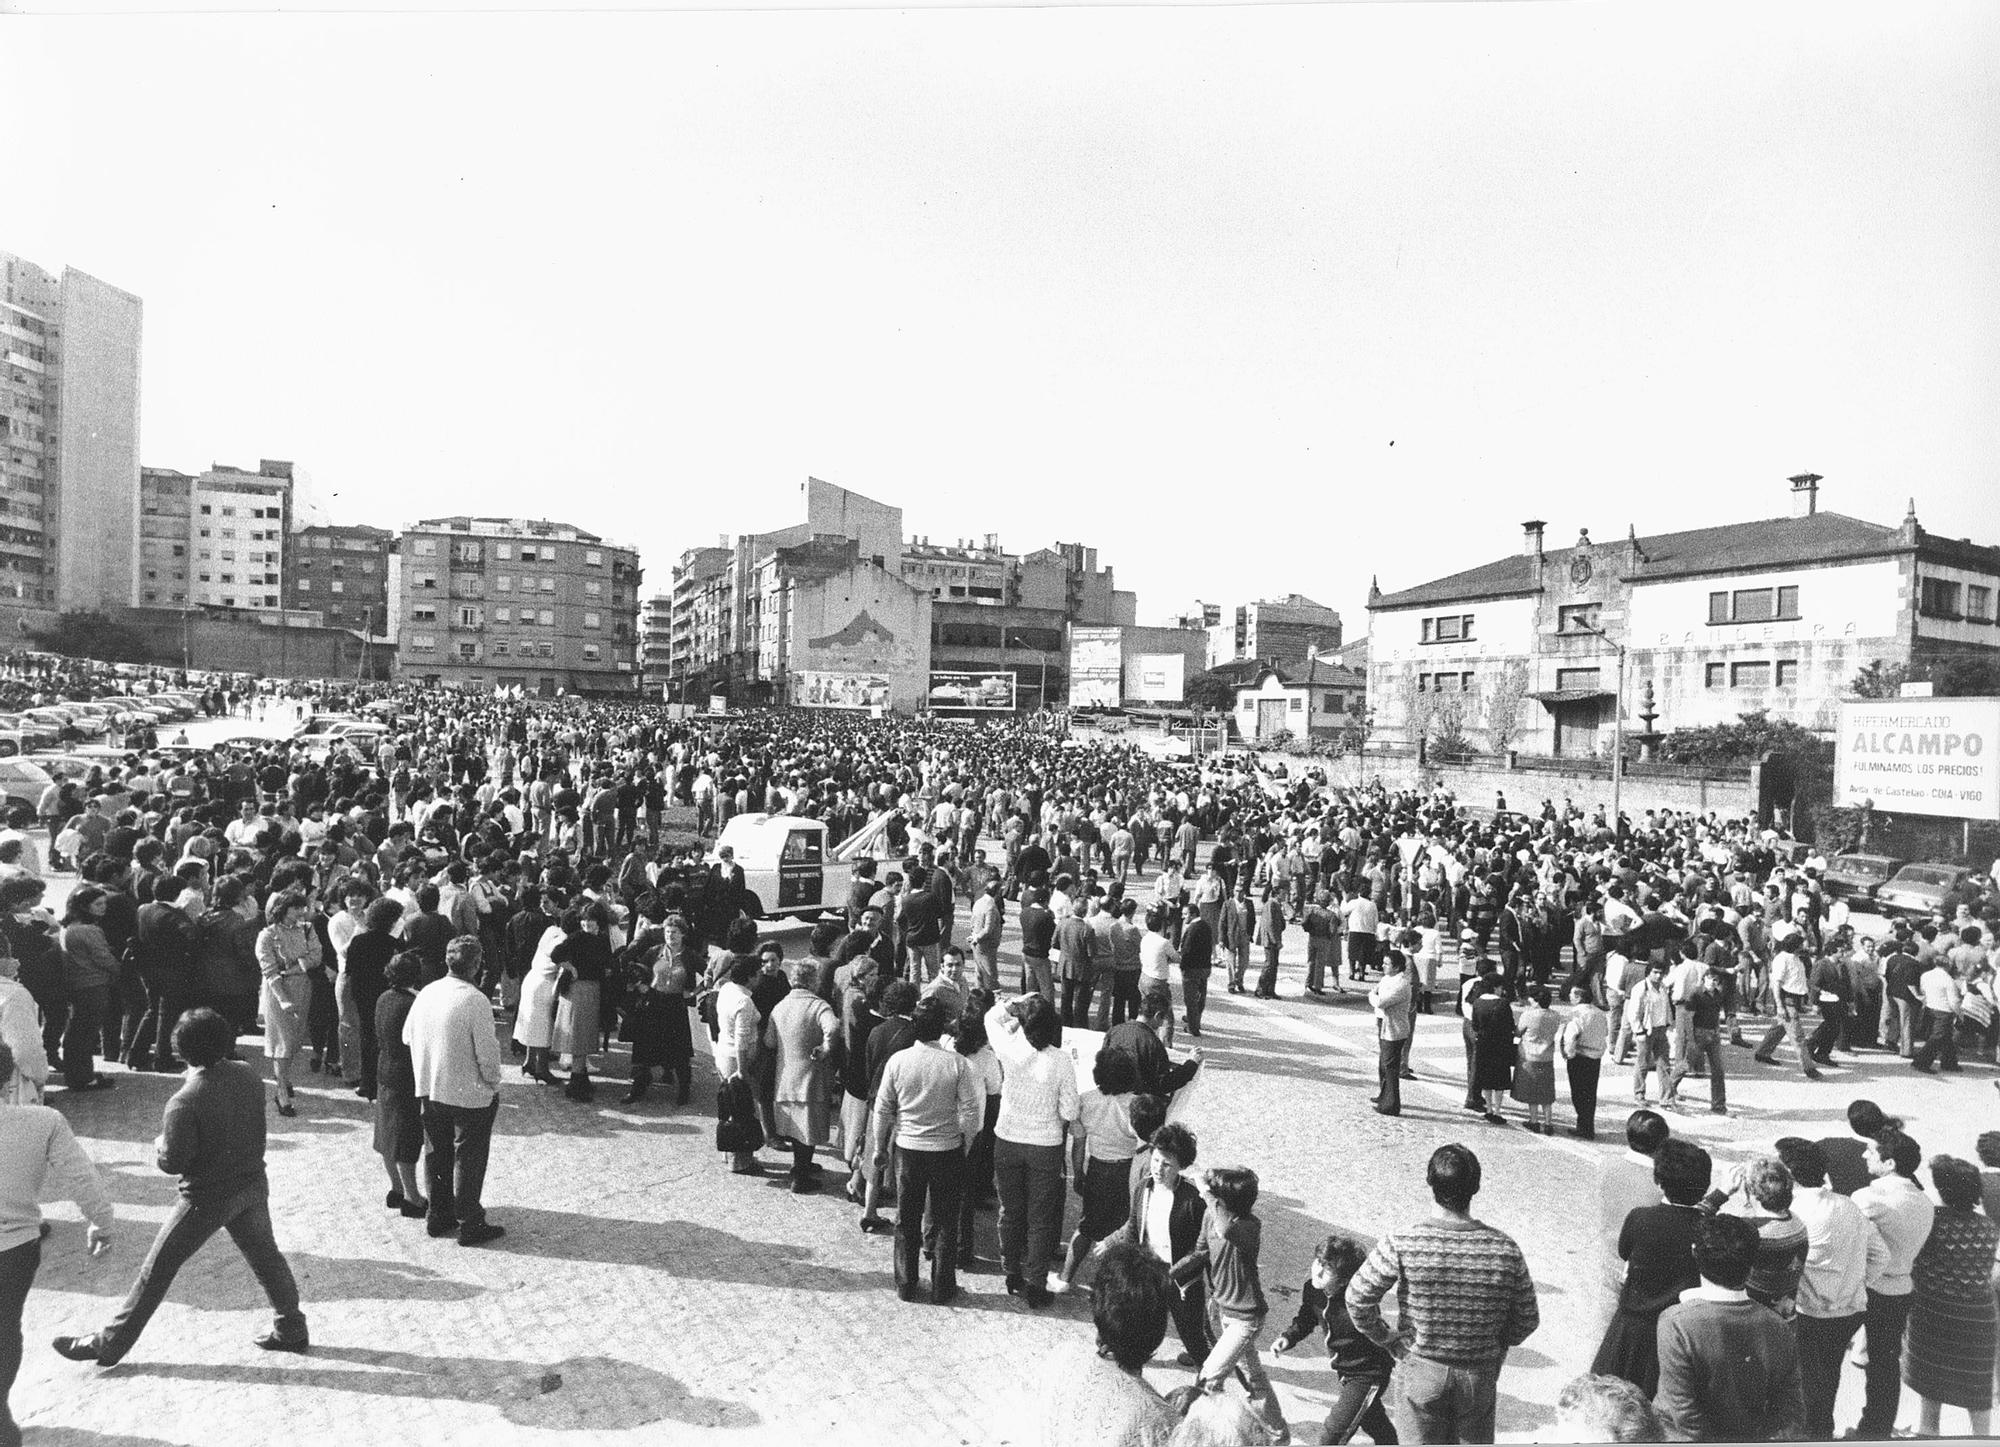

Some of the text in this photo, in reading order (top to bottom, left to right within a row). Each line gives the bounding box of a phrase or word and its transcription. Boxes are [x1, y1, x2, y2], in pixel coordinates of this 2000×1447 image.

[1659, 622, 1856, 645] BANDEIRA
[1853, 715, 1951, 728] HIPERMERCADO
[1852, 732, 1983, 757] ALCAMPO
[1917, 763, 1934, 774] LOS
[1938, 764, 1983, 777] PRECIOS!
[1873, 785, 1883, 795] de
[1960, 790, 1983, 802] VIGO
